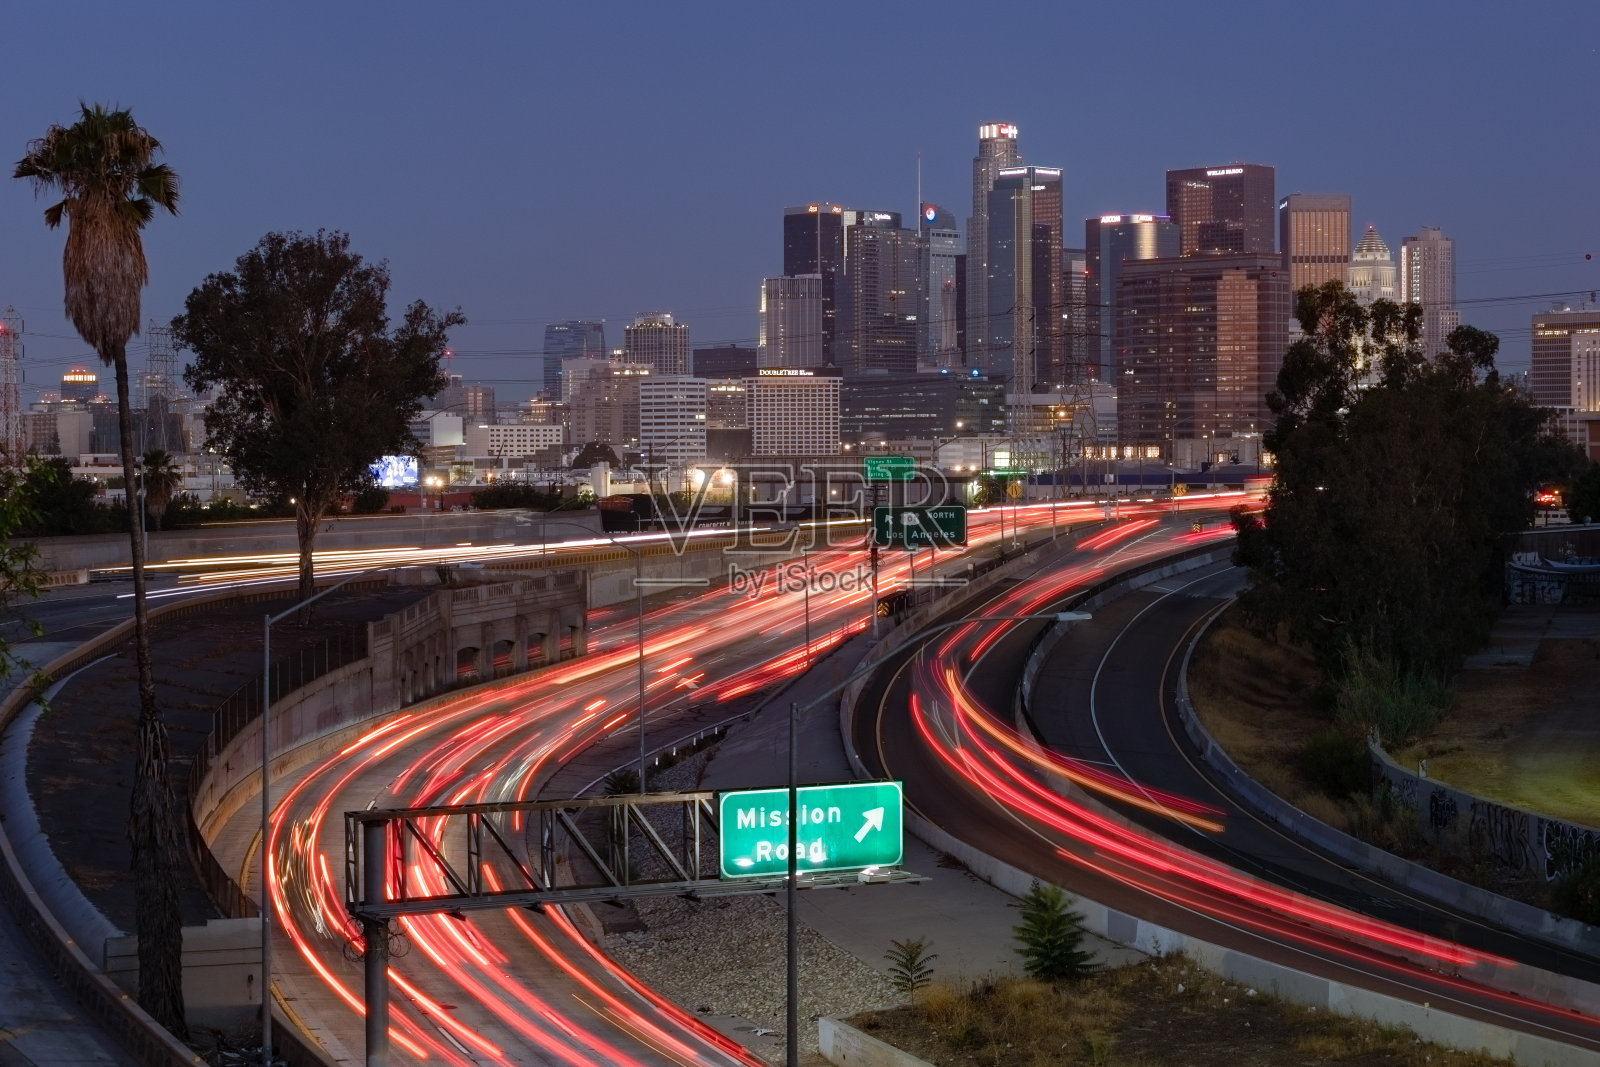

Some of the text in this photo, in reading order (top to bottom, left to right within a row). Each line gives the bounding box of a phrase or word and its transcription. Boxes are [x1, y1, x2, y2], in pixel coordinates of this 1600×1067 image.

[928, 511, 955, 519] NORTH
[886, 530, 956, 541] Los Angeles
[756, 837, 824, 862] Road
